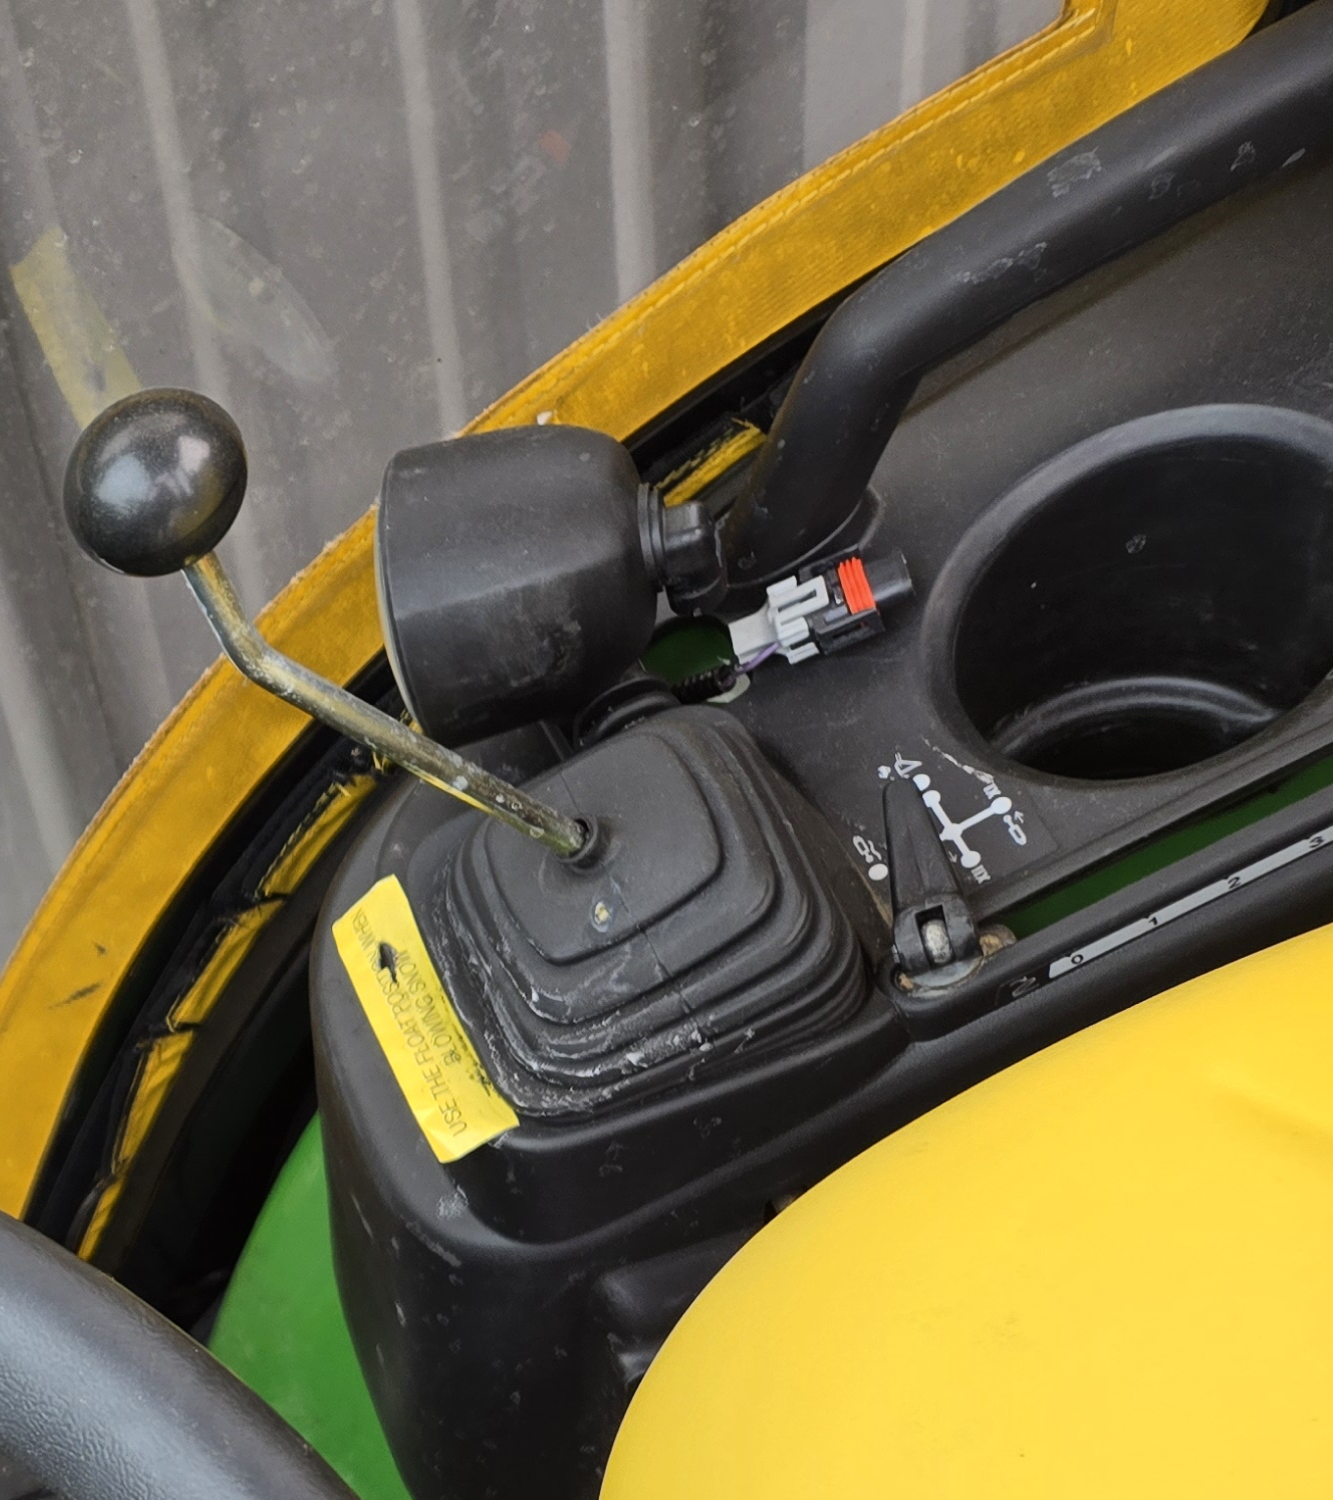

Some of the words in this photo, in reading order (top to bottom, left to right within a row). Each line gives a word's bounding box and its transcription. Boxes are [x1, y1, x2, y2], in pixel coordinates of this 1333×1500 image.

[1309, 836, 1325, 849] 3
[1227, 876, 1241, 889] 2
[350, 908, 378, 948] WHEN
[1148, 916, 1159, 926] 1
[394, 950, 426, 994] SNOW
[1071, 954, 1084, 965] 0
[397, 1017, 433, 1065] FLOAT
[414, 994, 463, 1065] BLOWING
[422, 1065, 451, 1099] THE
[439, 1098, 468, 1136] USE
